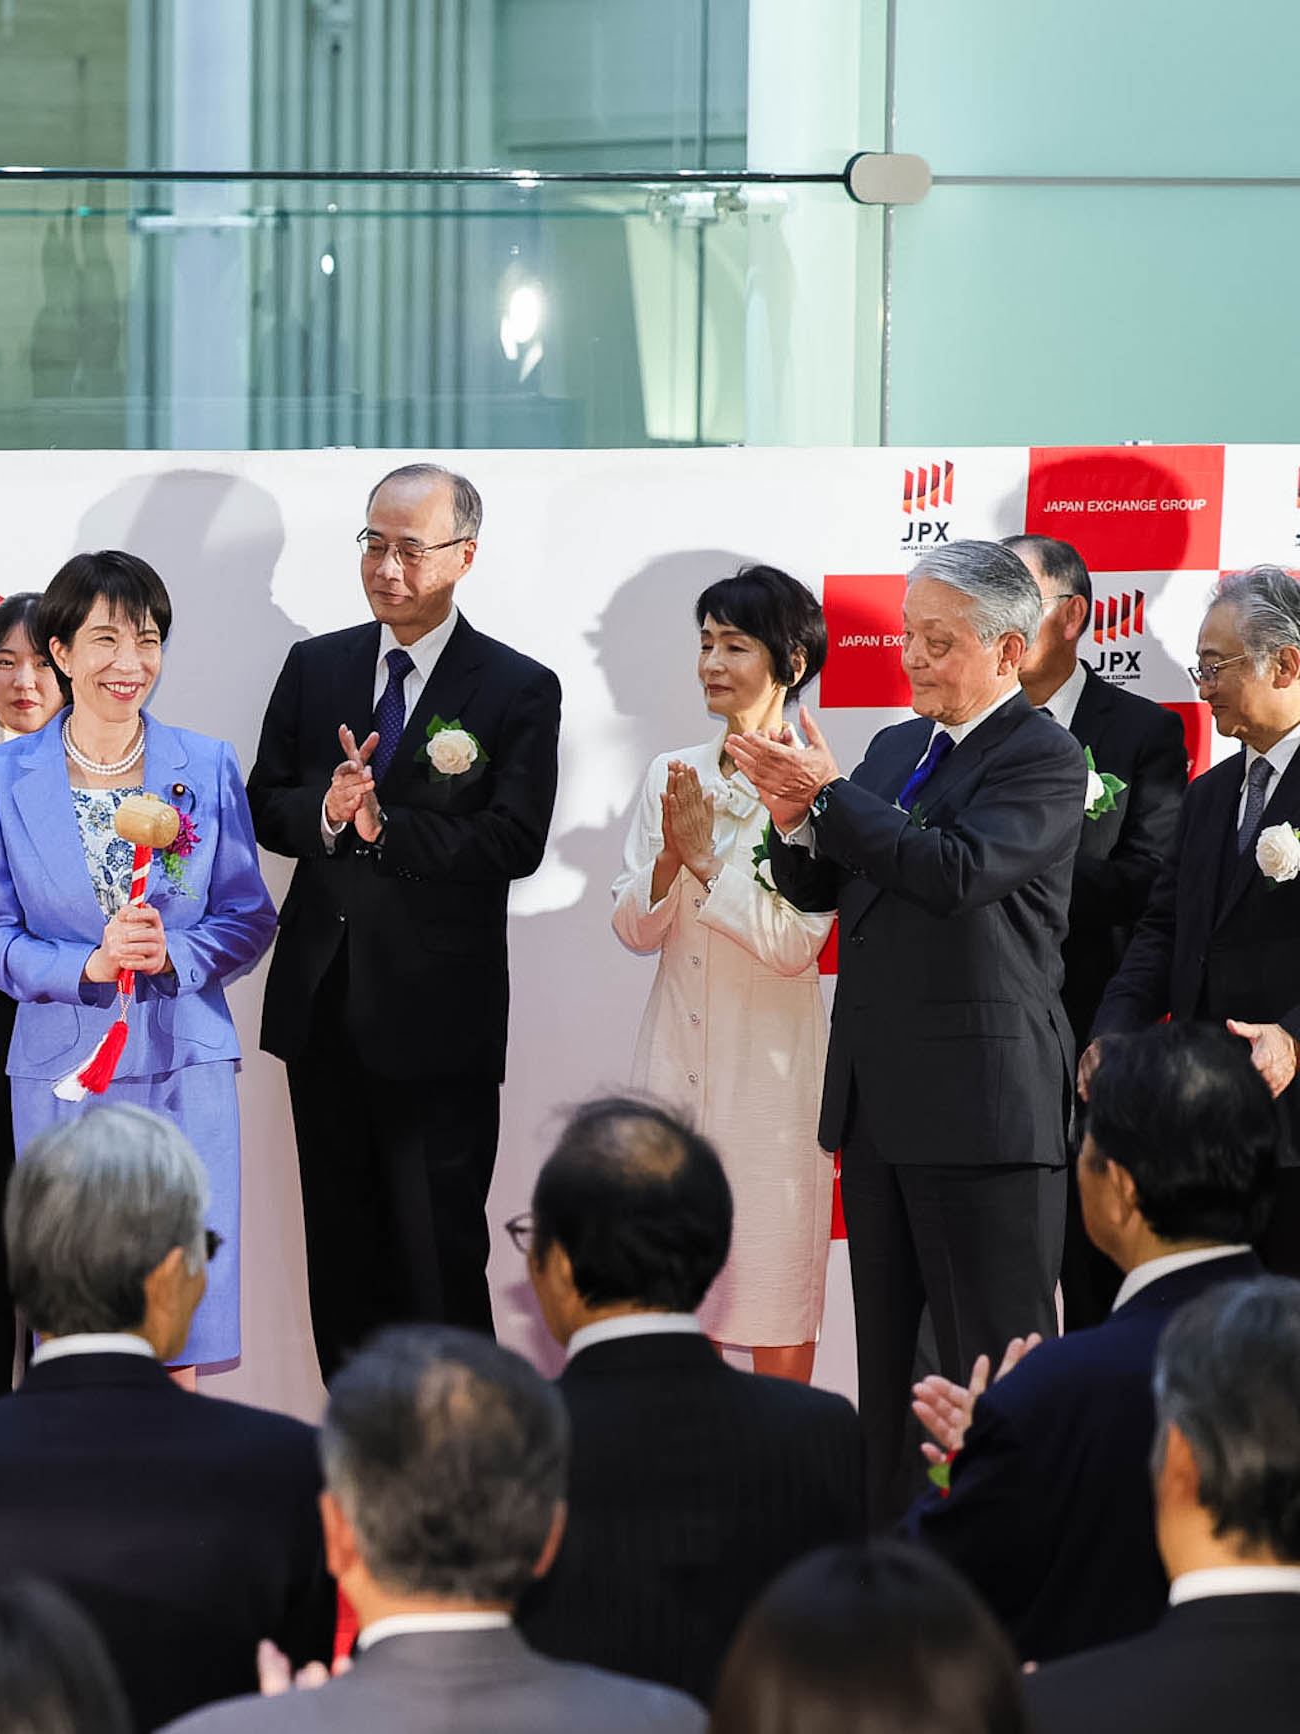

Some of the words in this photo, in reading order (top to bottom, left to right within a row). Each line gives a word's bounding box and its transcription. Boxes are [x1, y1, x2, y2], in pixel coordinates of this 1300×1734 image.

[1043, 501, 1084, 512] JAPAN
[1087, 500, 1157, 512] EXCHANGE
[1160, 499, 1207, 511] GROUP
[901, 521, 950, 542] JPX
[838, 634, 880, 647] JAPAN
[1095, 651, 1141, 672] JPX
